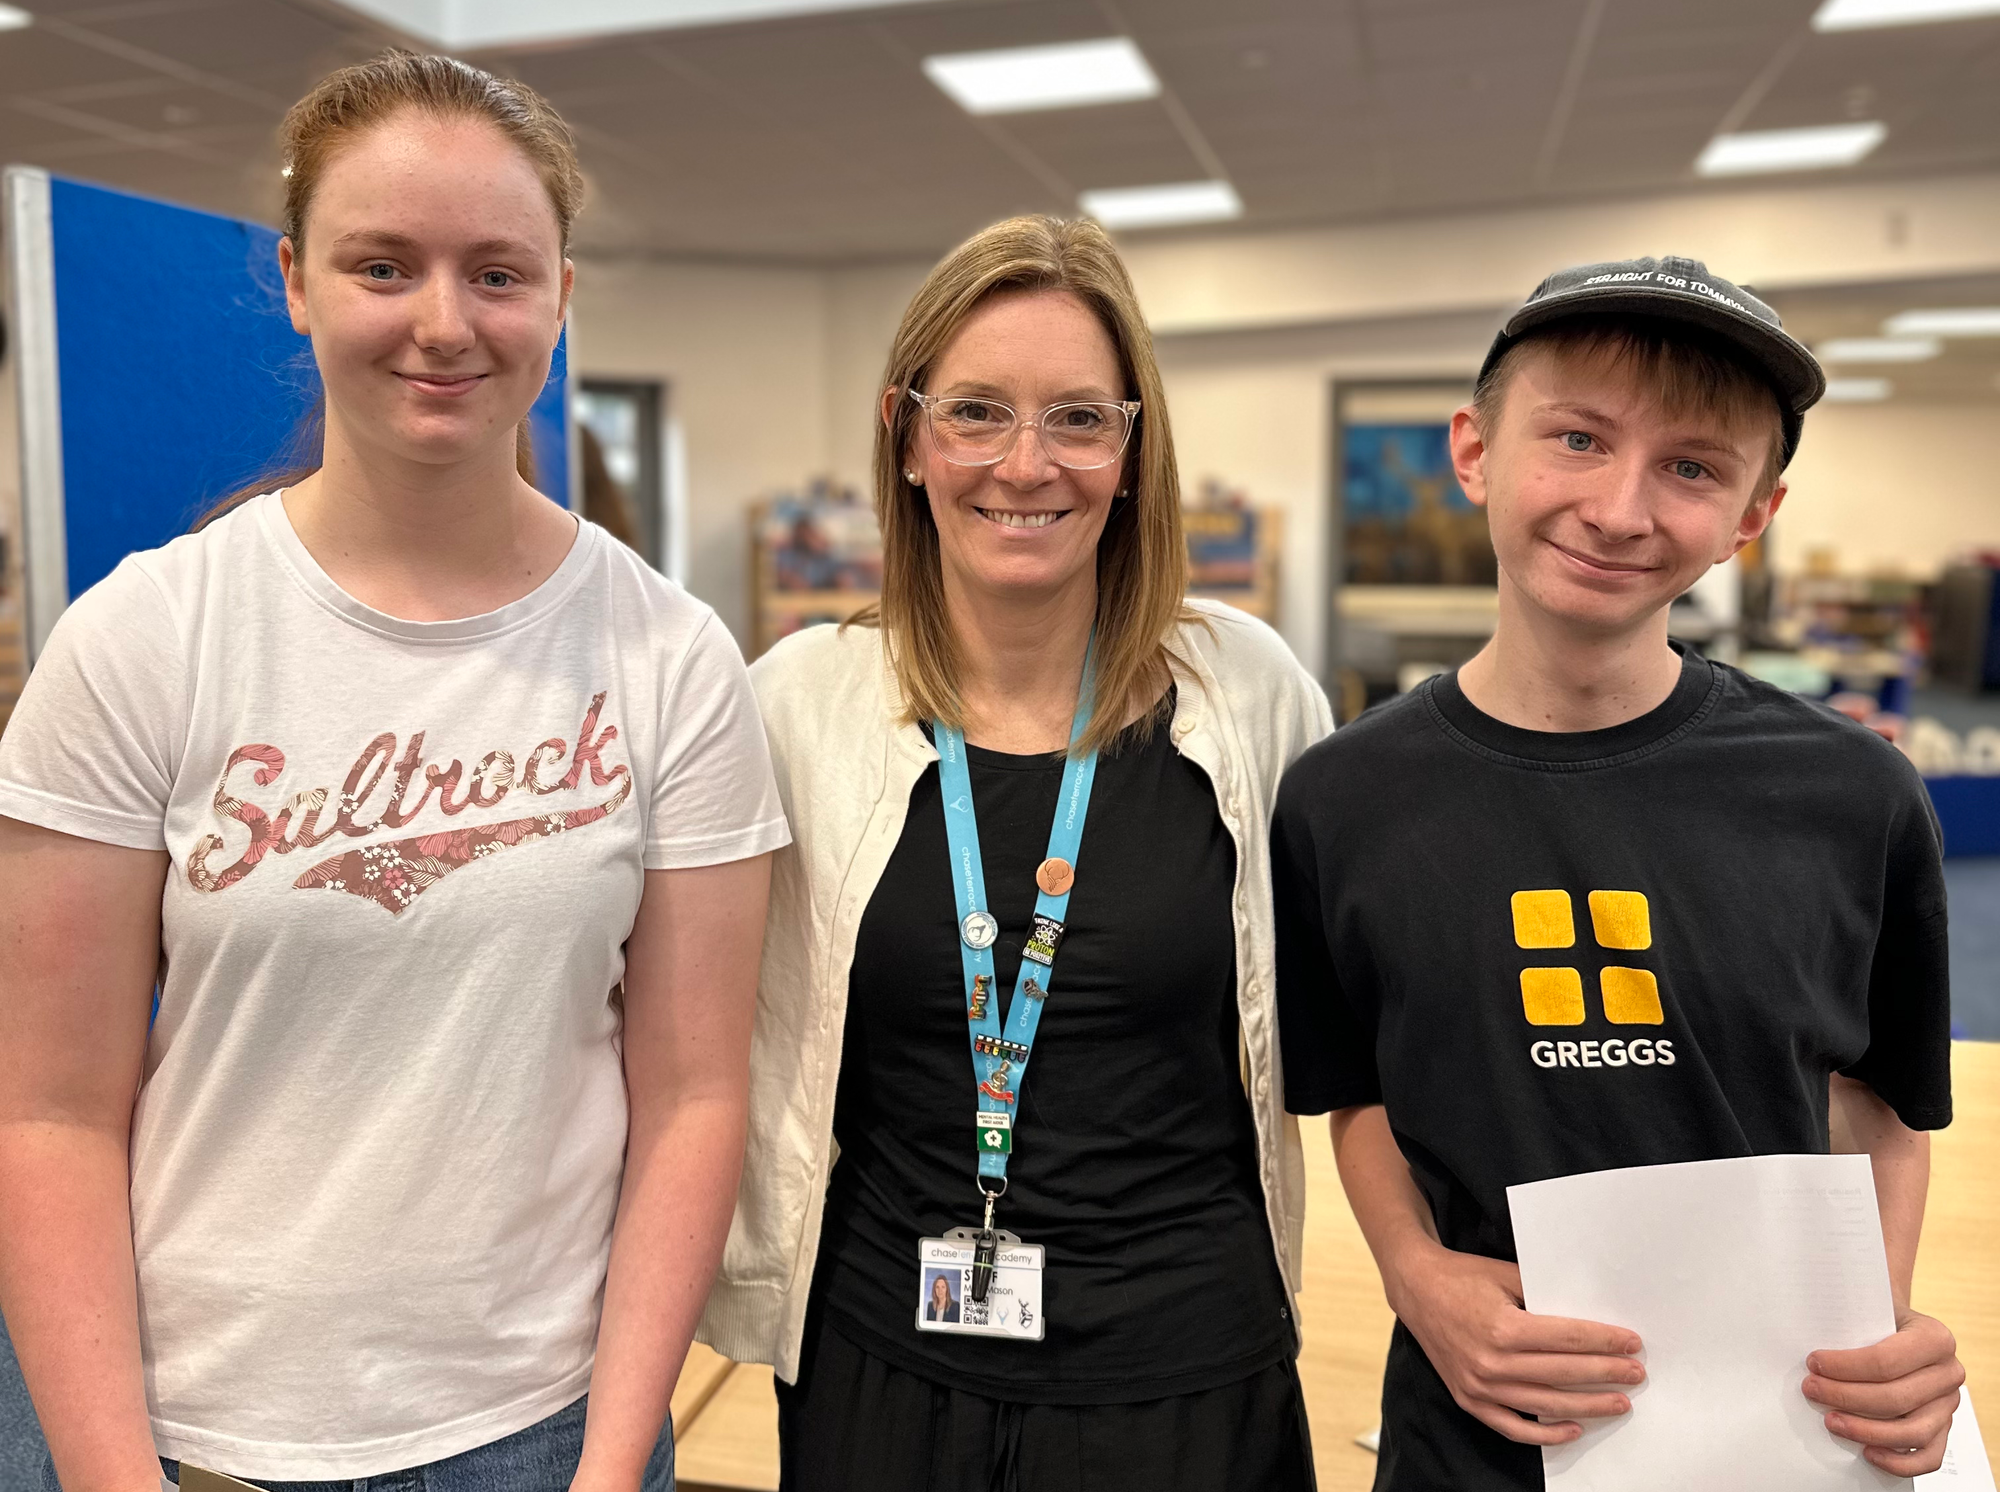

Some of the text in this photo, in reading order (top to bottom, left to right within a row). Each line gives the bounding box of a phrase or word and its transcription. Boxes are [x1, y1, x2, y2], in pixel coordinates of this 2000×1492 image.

[1583, 271, 1654, 286] STRAIGHT
[1656, 273, 1687, 289] FOR
[187, 690, 631, 894] Saltrock
[1049, 920, 1061, 931] LIKE
[1026, 939, 1055, 957] PROTON
[1530, 1039, 1676, 1069] GREGGS
[987, 1285, 1014, 1296] Mason
